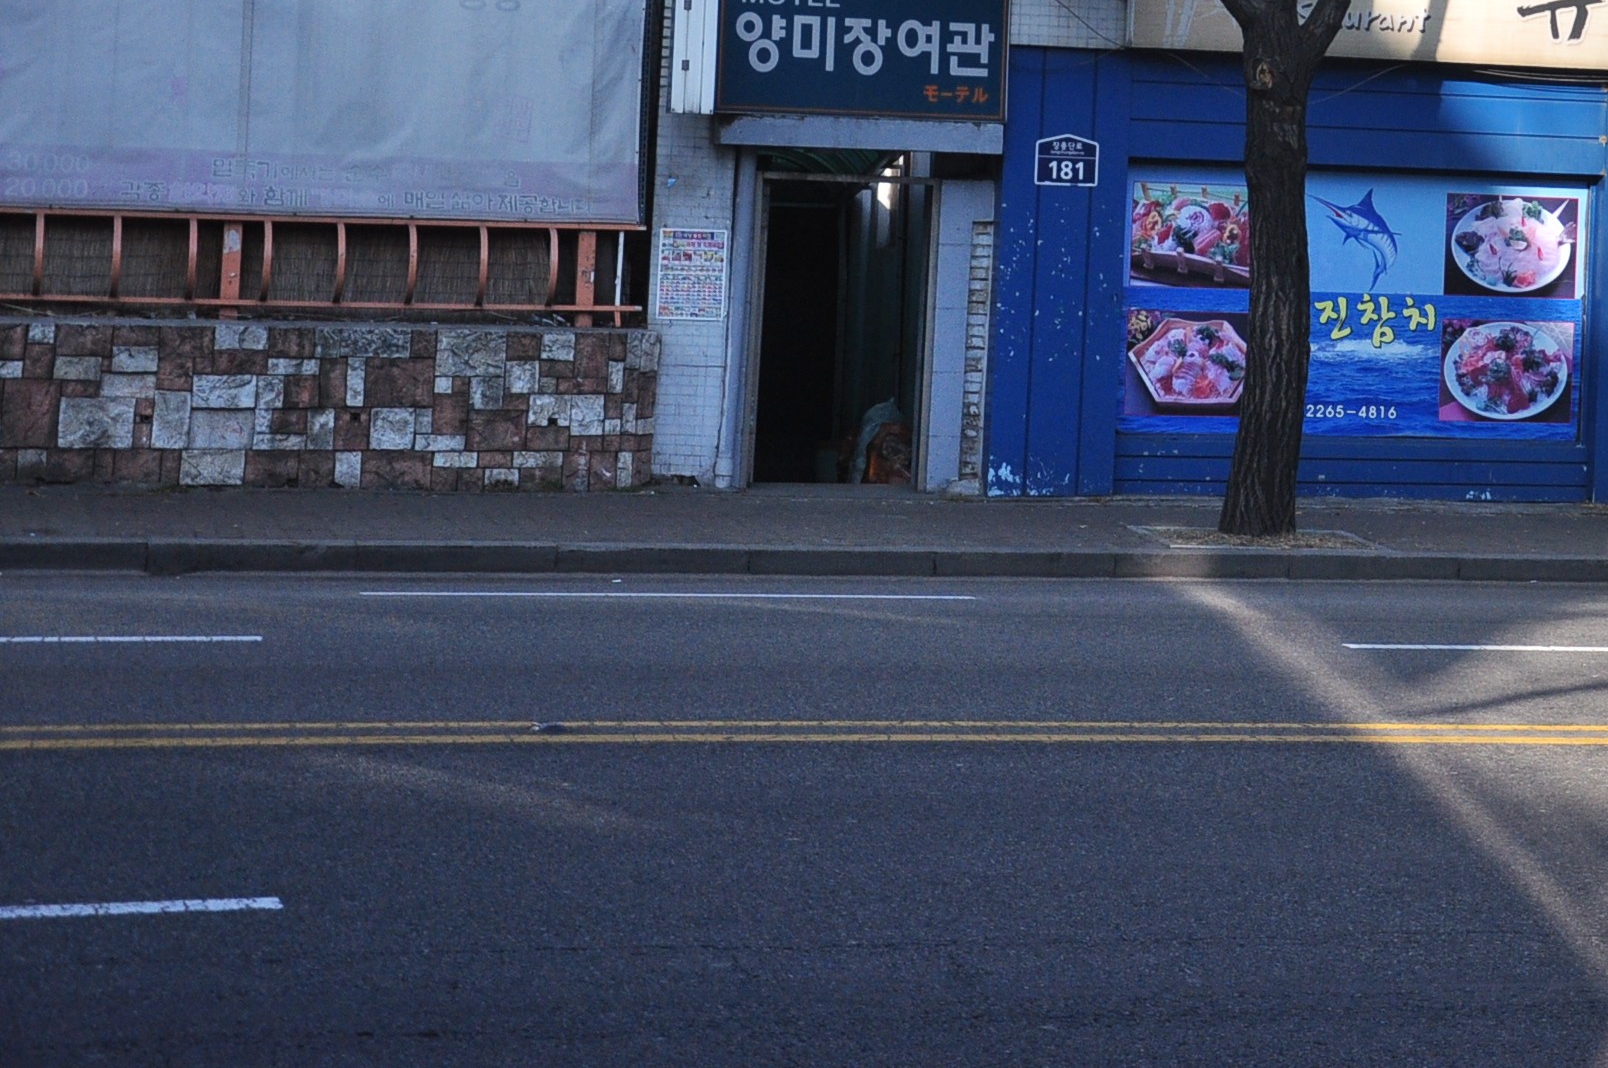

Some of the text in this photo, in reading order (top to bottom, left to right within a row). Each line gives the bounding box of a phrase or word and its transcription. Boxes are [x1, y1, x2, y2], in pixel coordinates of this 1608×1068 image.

[736, 11, 995, 77] 양미장여관
[922, 85, 988, 104] モーテル
[1049, 161, 1084, 180] 181
[1305, 404, 1397, 419] 2265-4816
